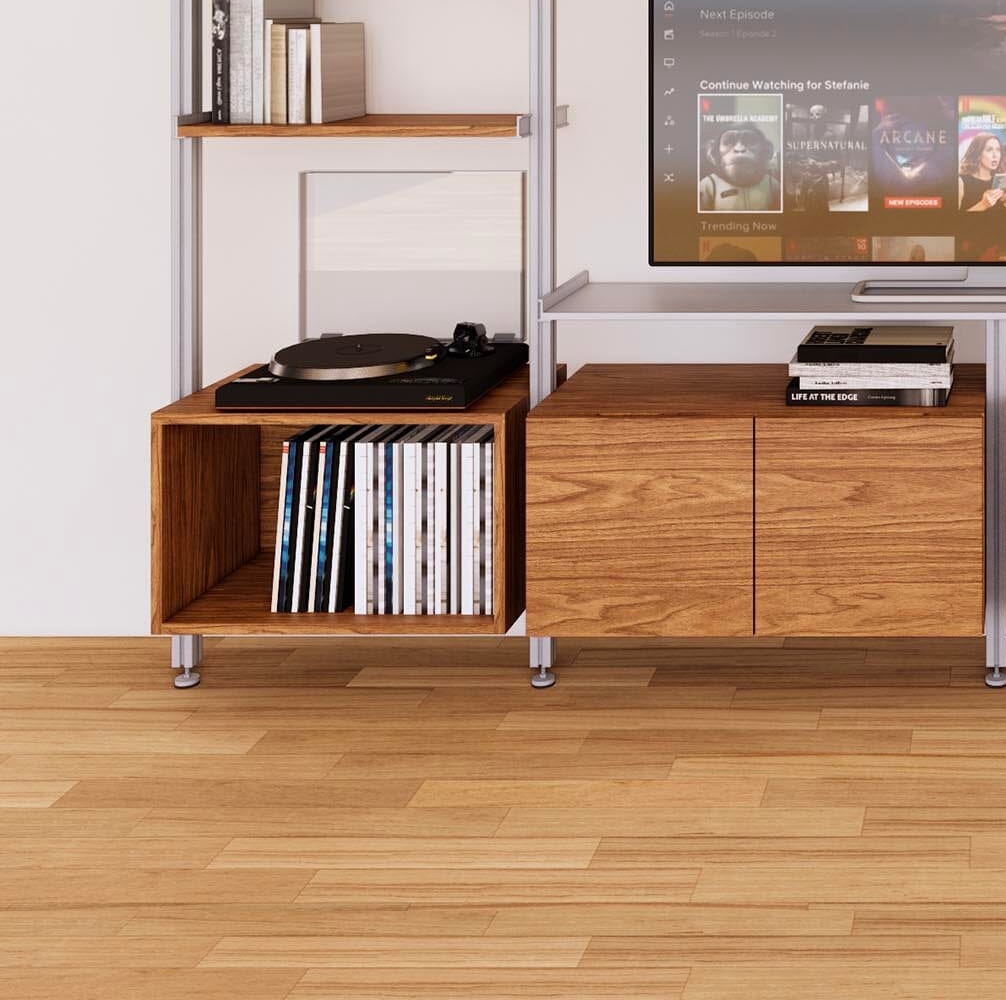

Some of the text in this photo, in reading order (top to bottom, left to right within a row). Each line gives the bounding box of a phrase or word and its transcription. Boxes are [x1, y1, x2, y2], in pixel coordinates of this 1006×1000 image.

[700, 9, 775, 22] Next Episode
[700, 80, 870, 92] Continue Watching for Stefanie
[880, 130, 947, 144] ARCANE
[787, 140, 867, 150] SUPERNATURAL
[700, 221, 777, 232] Trending Now
